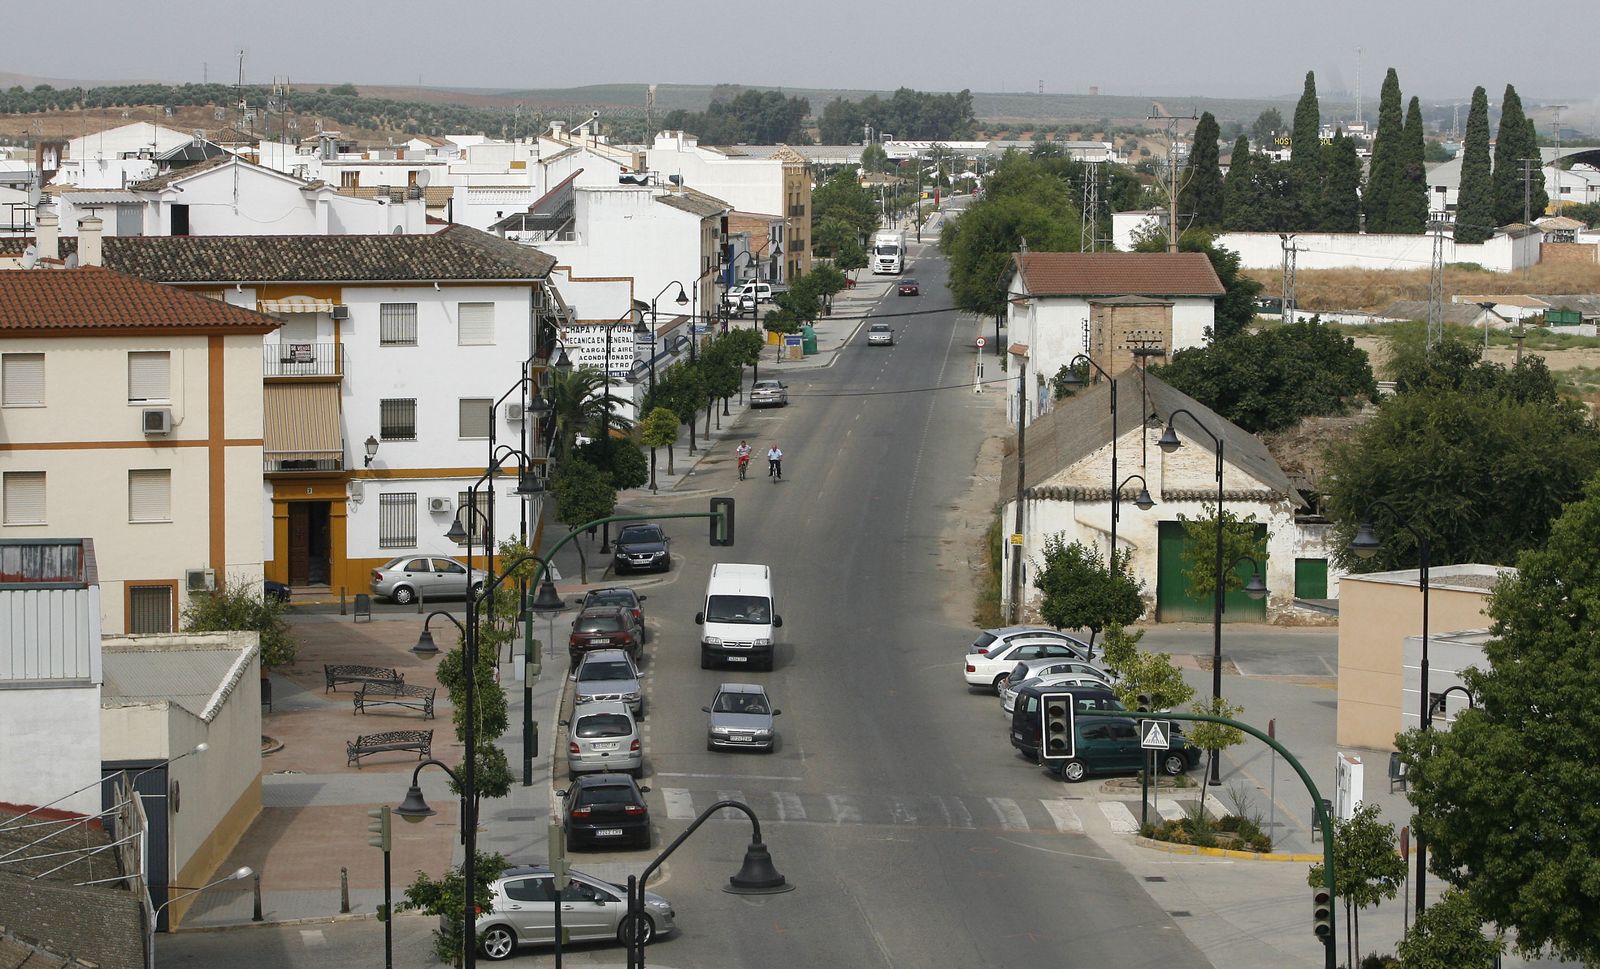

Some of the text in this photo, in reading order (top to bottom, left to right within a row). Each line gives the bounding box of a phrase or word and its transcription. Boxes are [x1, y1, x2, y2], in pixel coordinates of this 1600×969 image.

[565, 325, 632, 334] CHAPA Y PITURA
[606, 336, 633, 344] ENERAL
